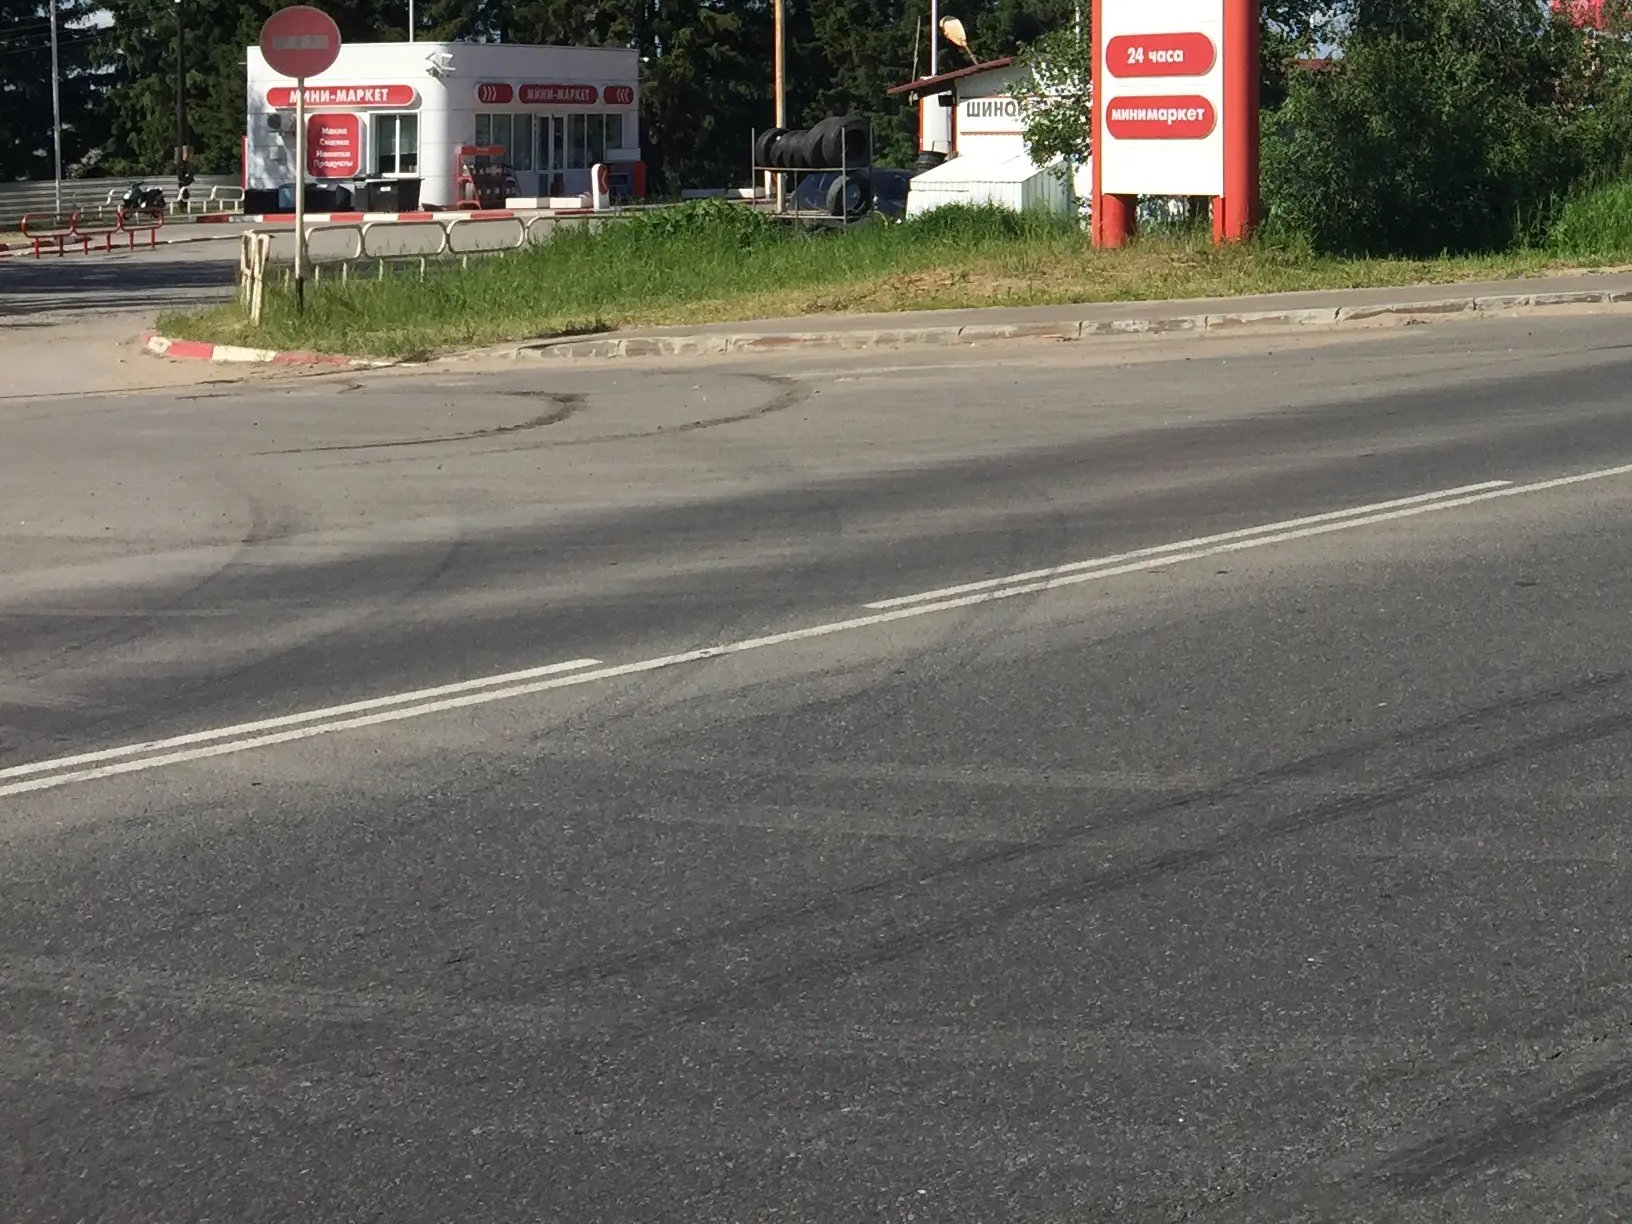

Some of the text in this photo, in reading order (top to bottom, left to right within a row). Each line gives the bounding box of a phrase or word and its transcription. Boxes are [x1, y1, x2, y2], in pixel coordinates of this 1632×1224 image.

[1127, 47, 1184, 64] 24 часа
[289, 88, 389, 104] МИНИ-МАРКЕТ
[526, 88, 590, 101] МИНИ-МАРКЕТ
[1111, 107, 1205, 125] минимаркет
